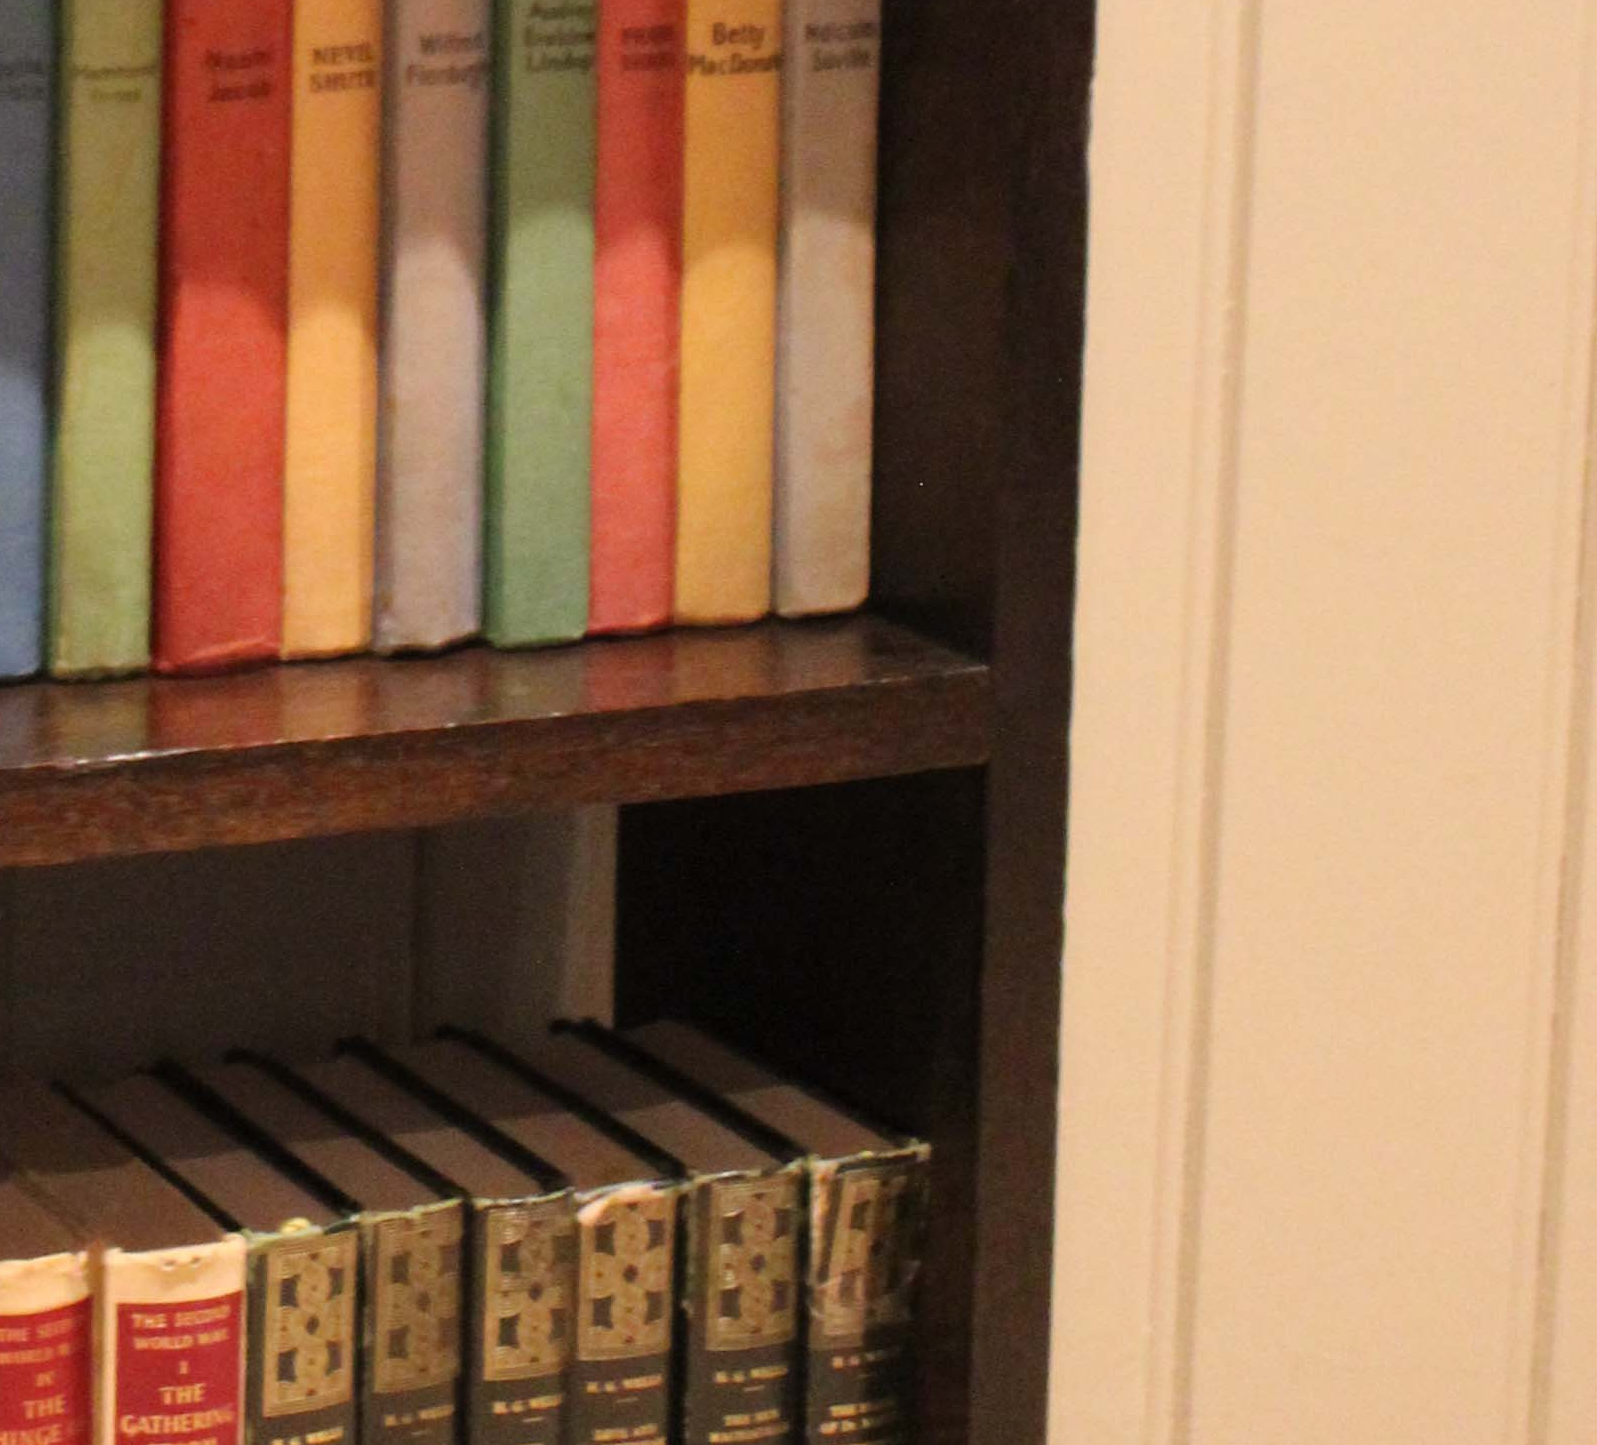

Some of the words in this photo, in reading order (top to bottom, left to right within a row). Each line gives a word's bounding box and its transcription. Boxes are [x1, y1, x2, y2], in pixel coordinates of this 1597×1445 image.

[710, 21, 766, 50] Betty
[311, 43, 374, 66] NEVIL
[309, 70, 376, 94] SHUTE
[131, 1312, 168, 1330] THE
[133, 1334, 193, 1351] WORLD
[158, 1382, 206, 1406] THE
[22, 1396, 68, 1421] THE
